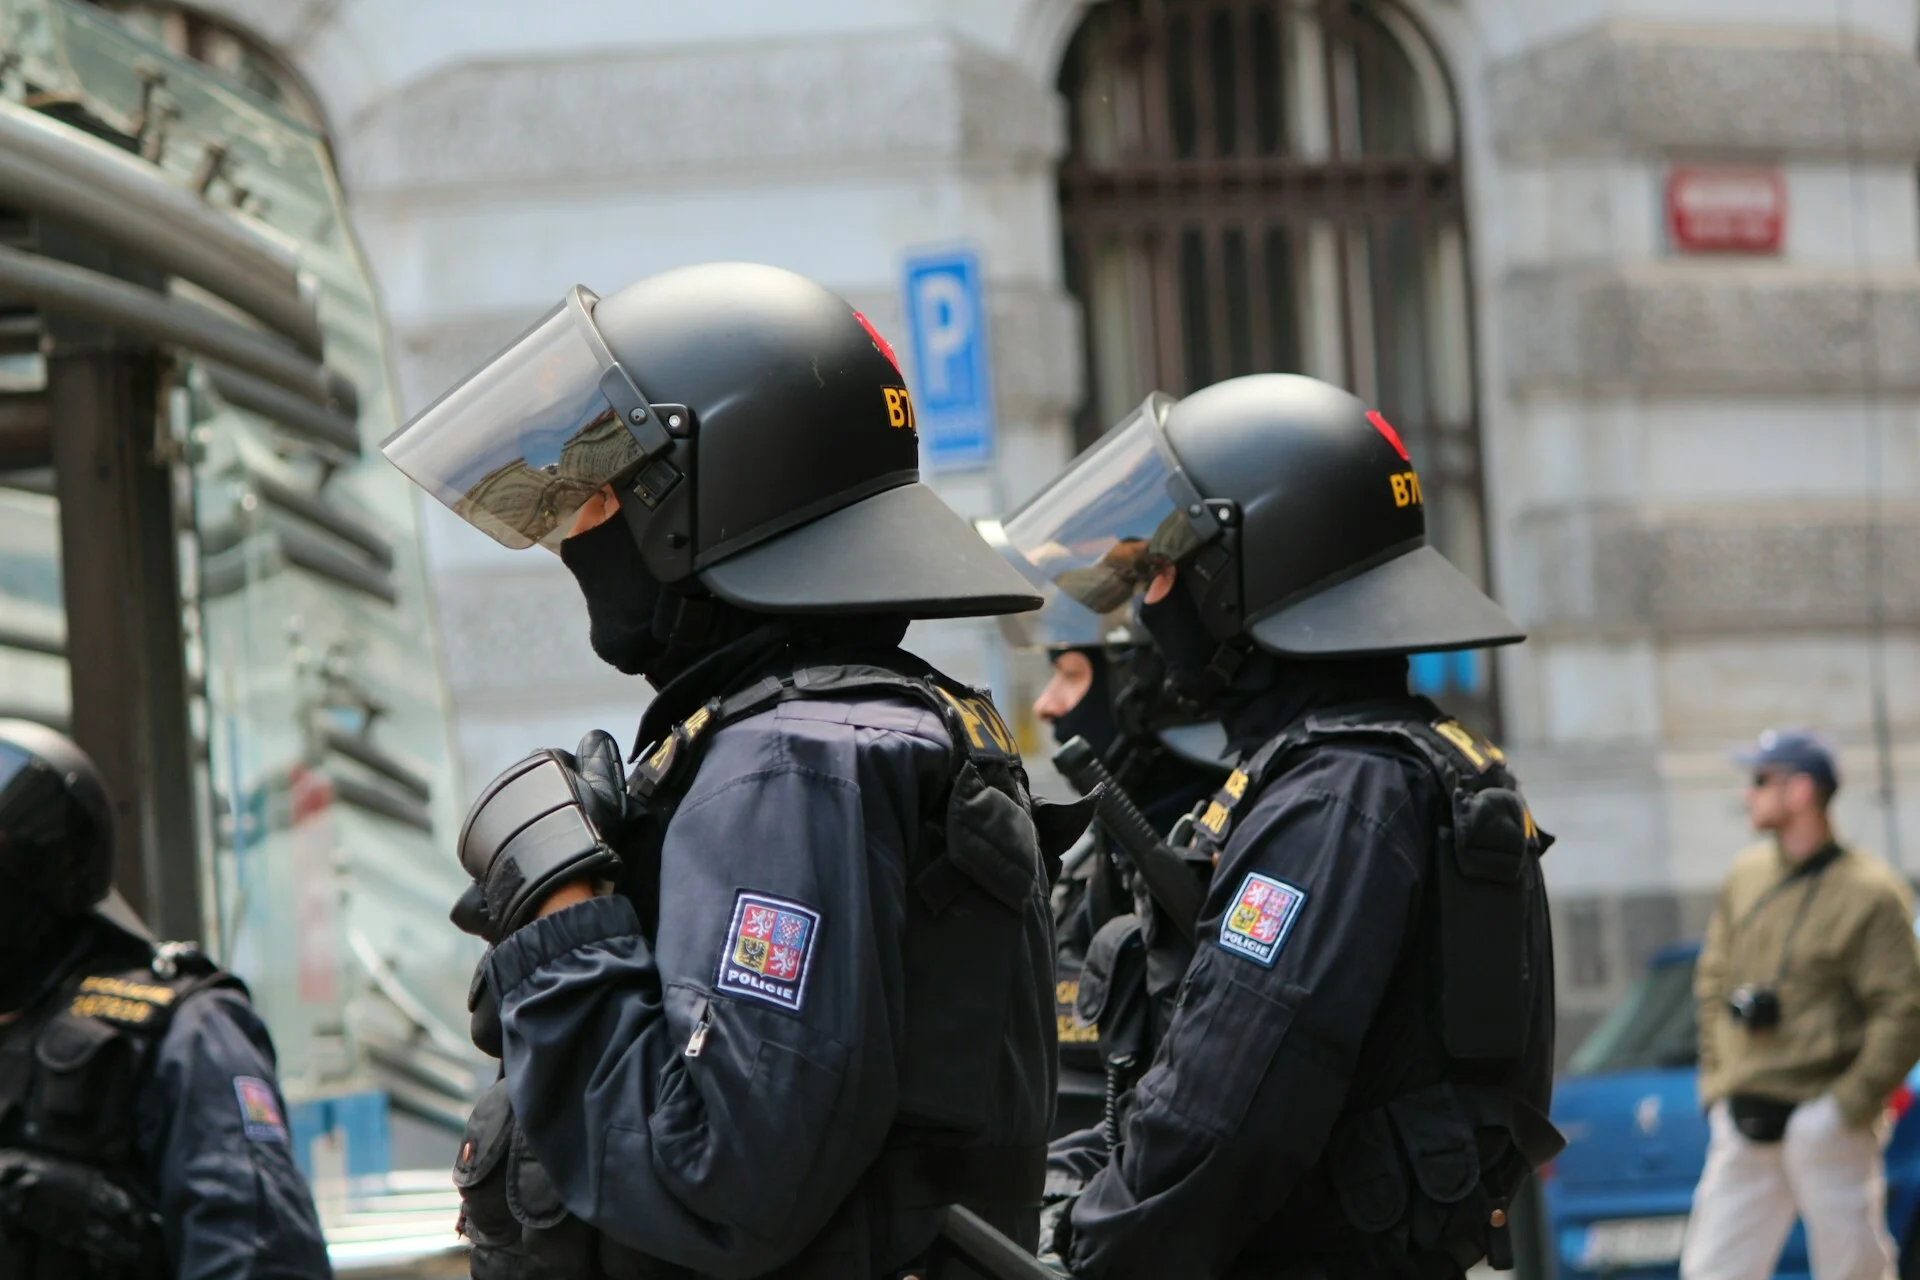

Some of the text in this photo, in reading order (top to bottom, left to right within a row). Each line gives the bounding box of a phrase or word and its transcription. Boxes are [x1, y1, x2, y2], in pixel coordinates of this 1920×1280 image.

[921, 274, 972, 396] P
[1223, 931, 1270, 957] POLICIE
[727, 969, 794, 1000] POLICIE
